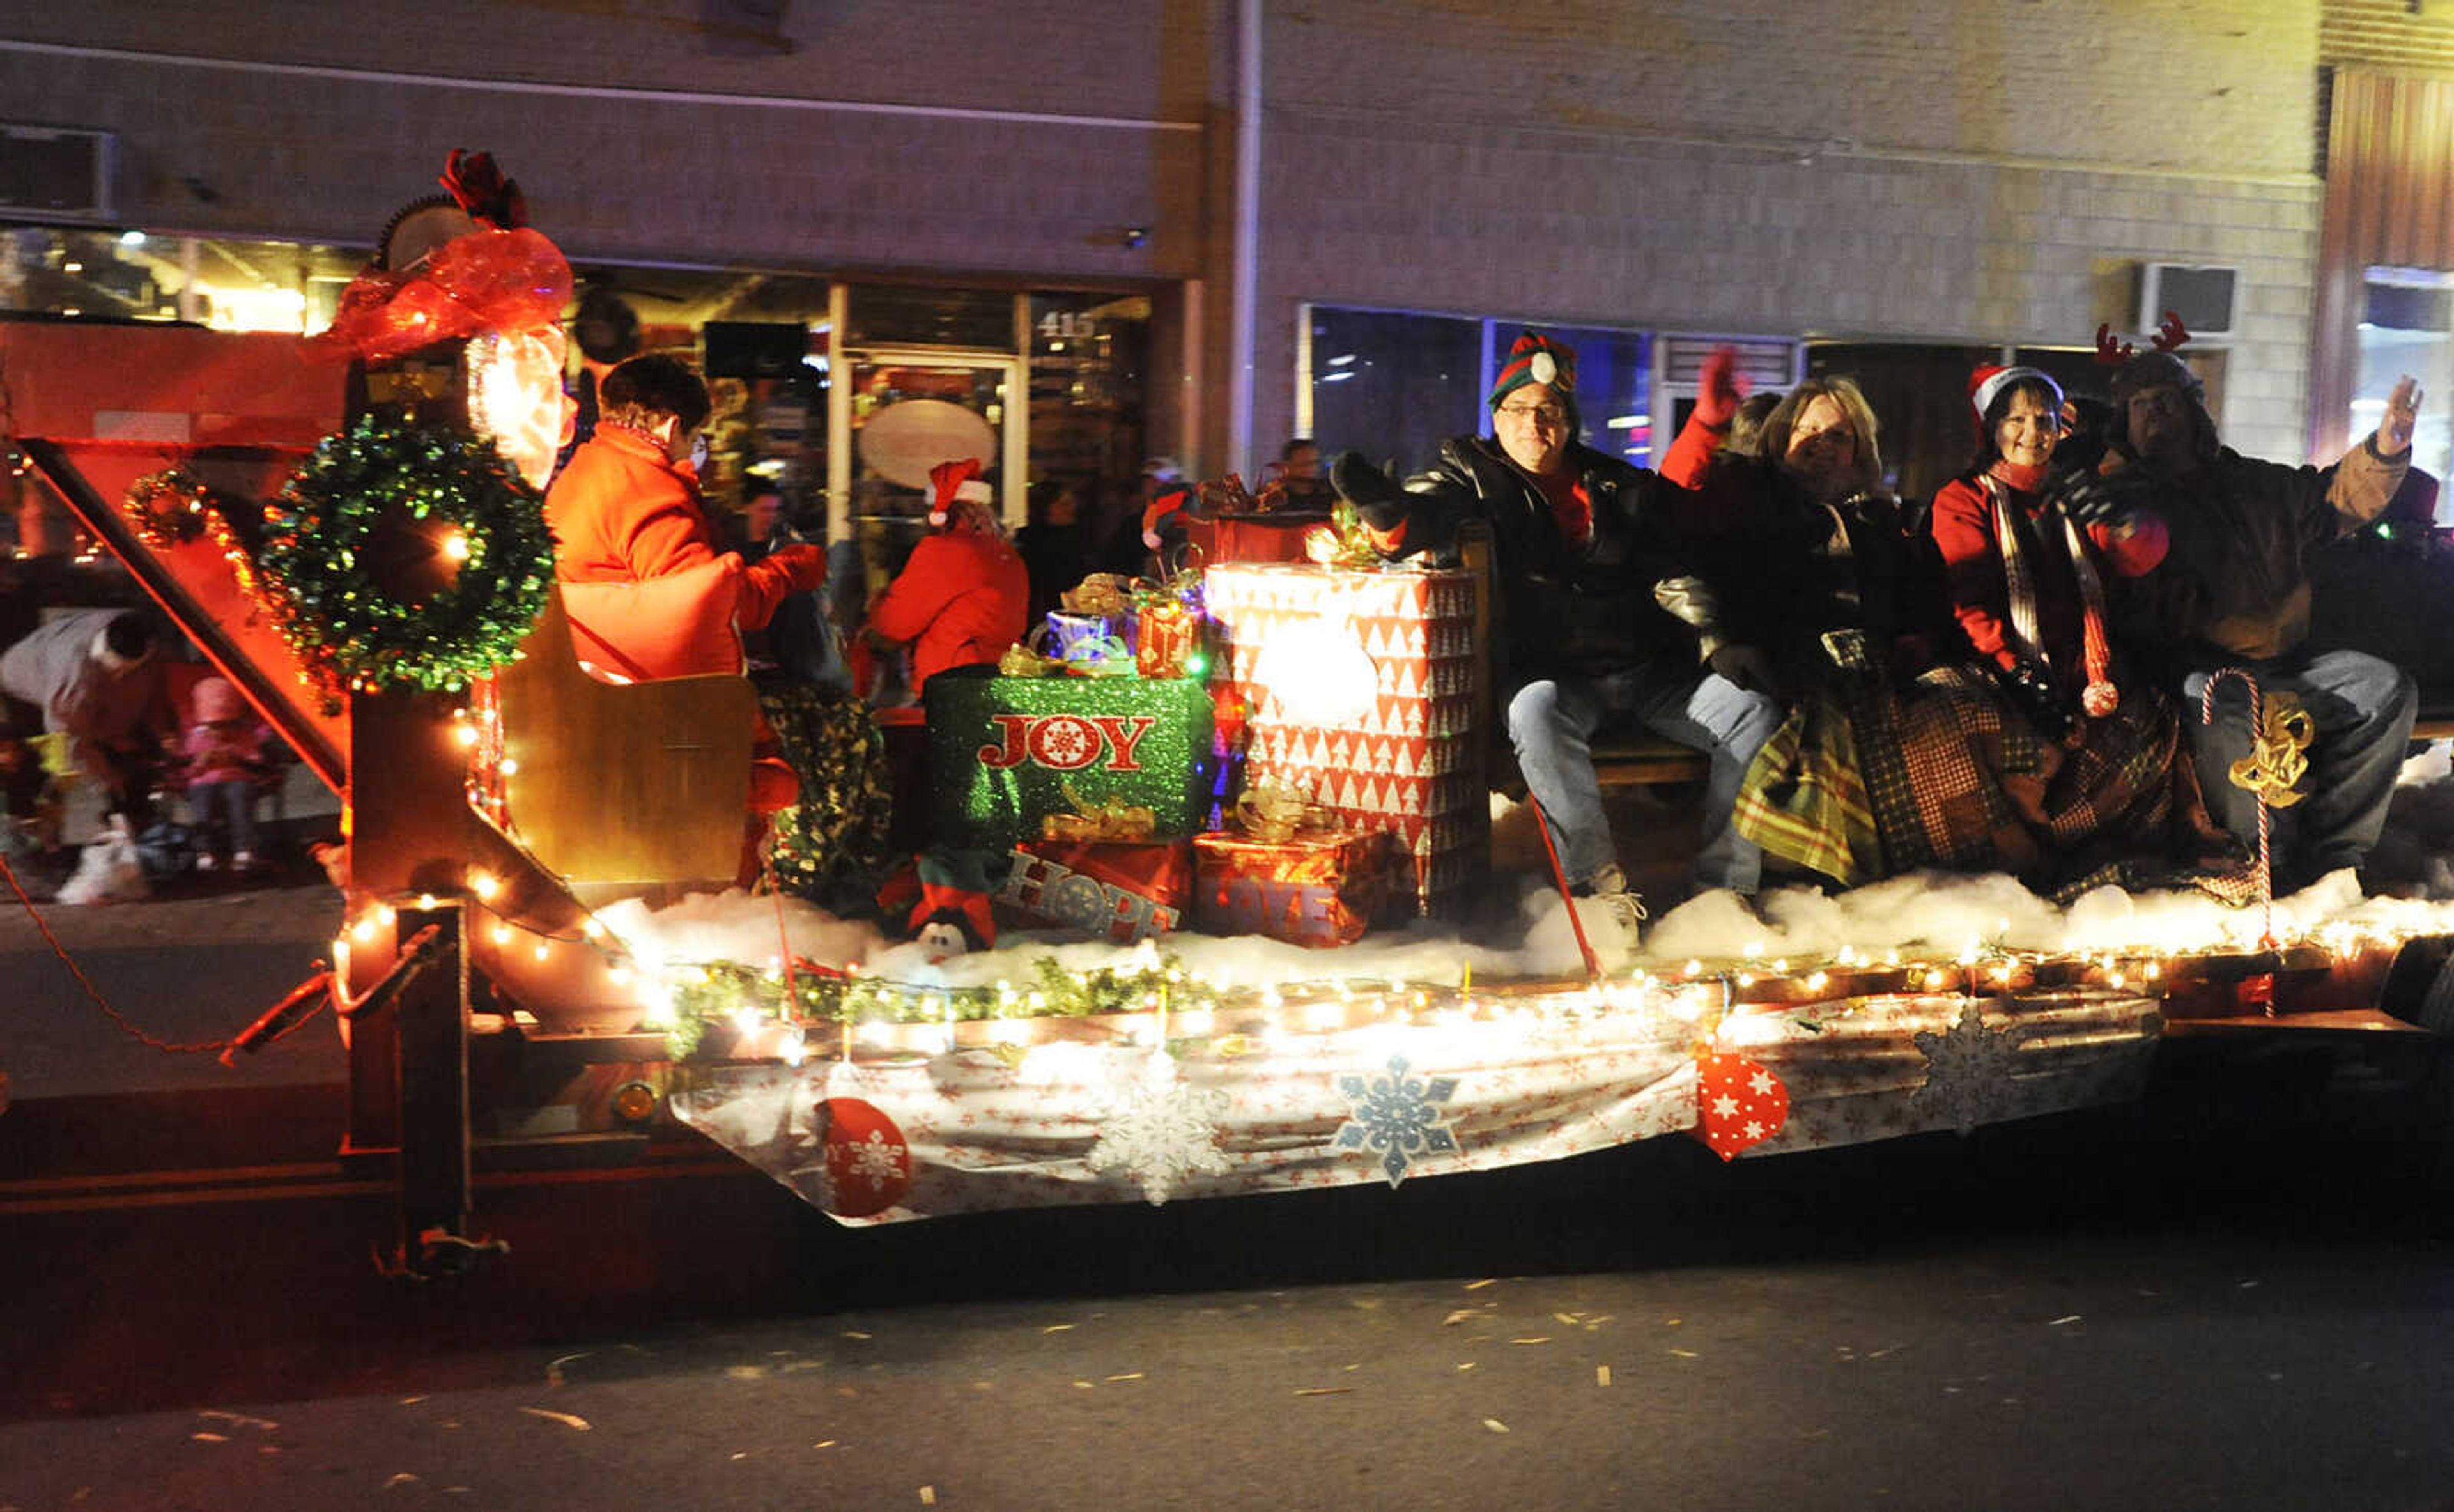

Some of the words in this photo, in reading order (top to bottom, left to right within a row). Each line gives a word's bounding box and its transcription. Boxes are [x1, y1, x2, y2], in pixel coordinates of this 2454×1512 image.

[1037, 311, 1094, 338] 415
[977, 713, 1155, 770] JOY
[988, 849, 1181, 943] HOPE
